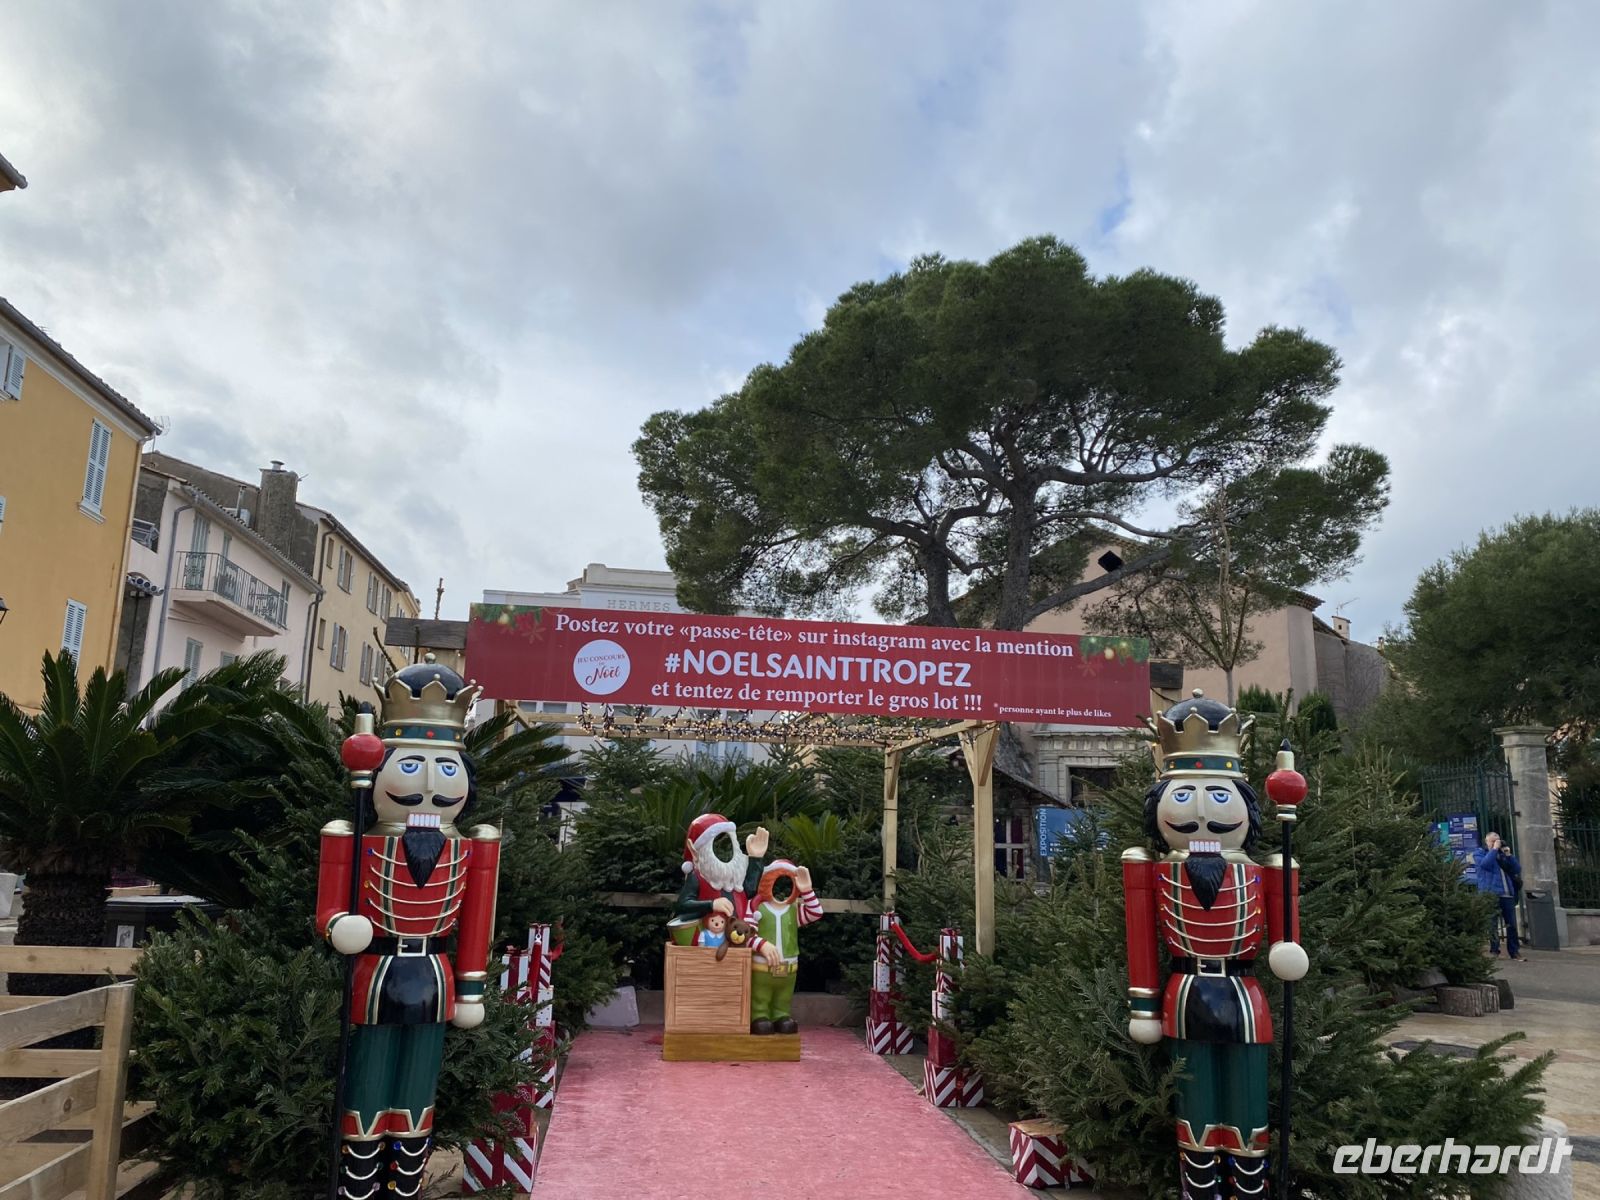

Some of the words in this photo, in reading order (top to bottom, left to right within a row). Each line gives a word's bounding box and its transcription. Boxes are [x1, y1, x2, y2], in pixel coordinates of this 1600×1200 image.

[556, 614, 619, 634] Postez
[624, 620, 675, 637] votre
[680, 625, 792, 642] «passe-tête»
[798, 629, 829, 646] sur
[833, 629, 926, 652] instagram
[931, 639, 971, 652] avec
[975, 636, 992, 653] la
[996, 640, 1074, 657] mention
[589, 653, 626, 661] CONCOURS
[664, 649, 971, 687] #NOELSAINTTROPEZ
[651, 682, 669, 698] et
[675, 683, 733, 700] tentez
[738, 685, 760, 701] de
[766, 689, 863, 708] remporter
[868, 689, 884, 706] le
[888, 694, 930, 712] gros
[934, 691, 959, 710] lot
[964, 694, 982, 712] !!!
[1035, 708, 1056, 716] ayant
[1066, 708, 1081, 717] plus
[1083, 709, 1093, 717] de
[1094, 709, 1111, 718] likes
